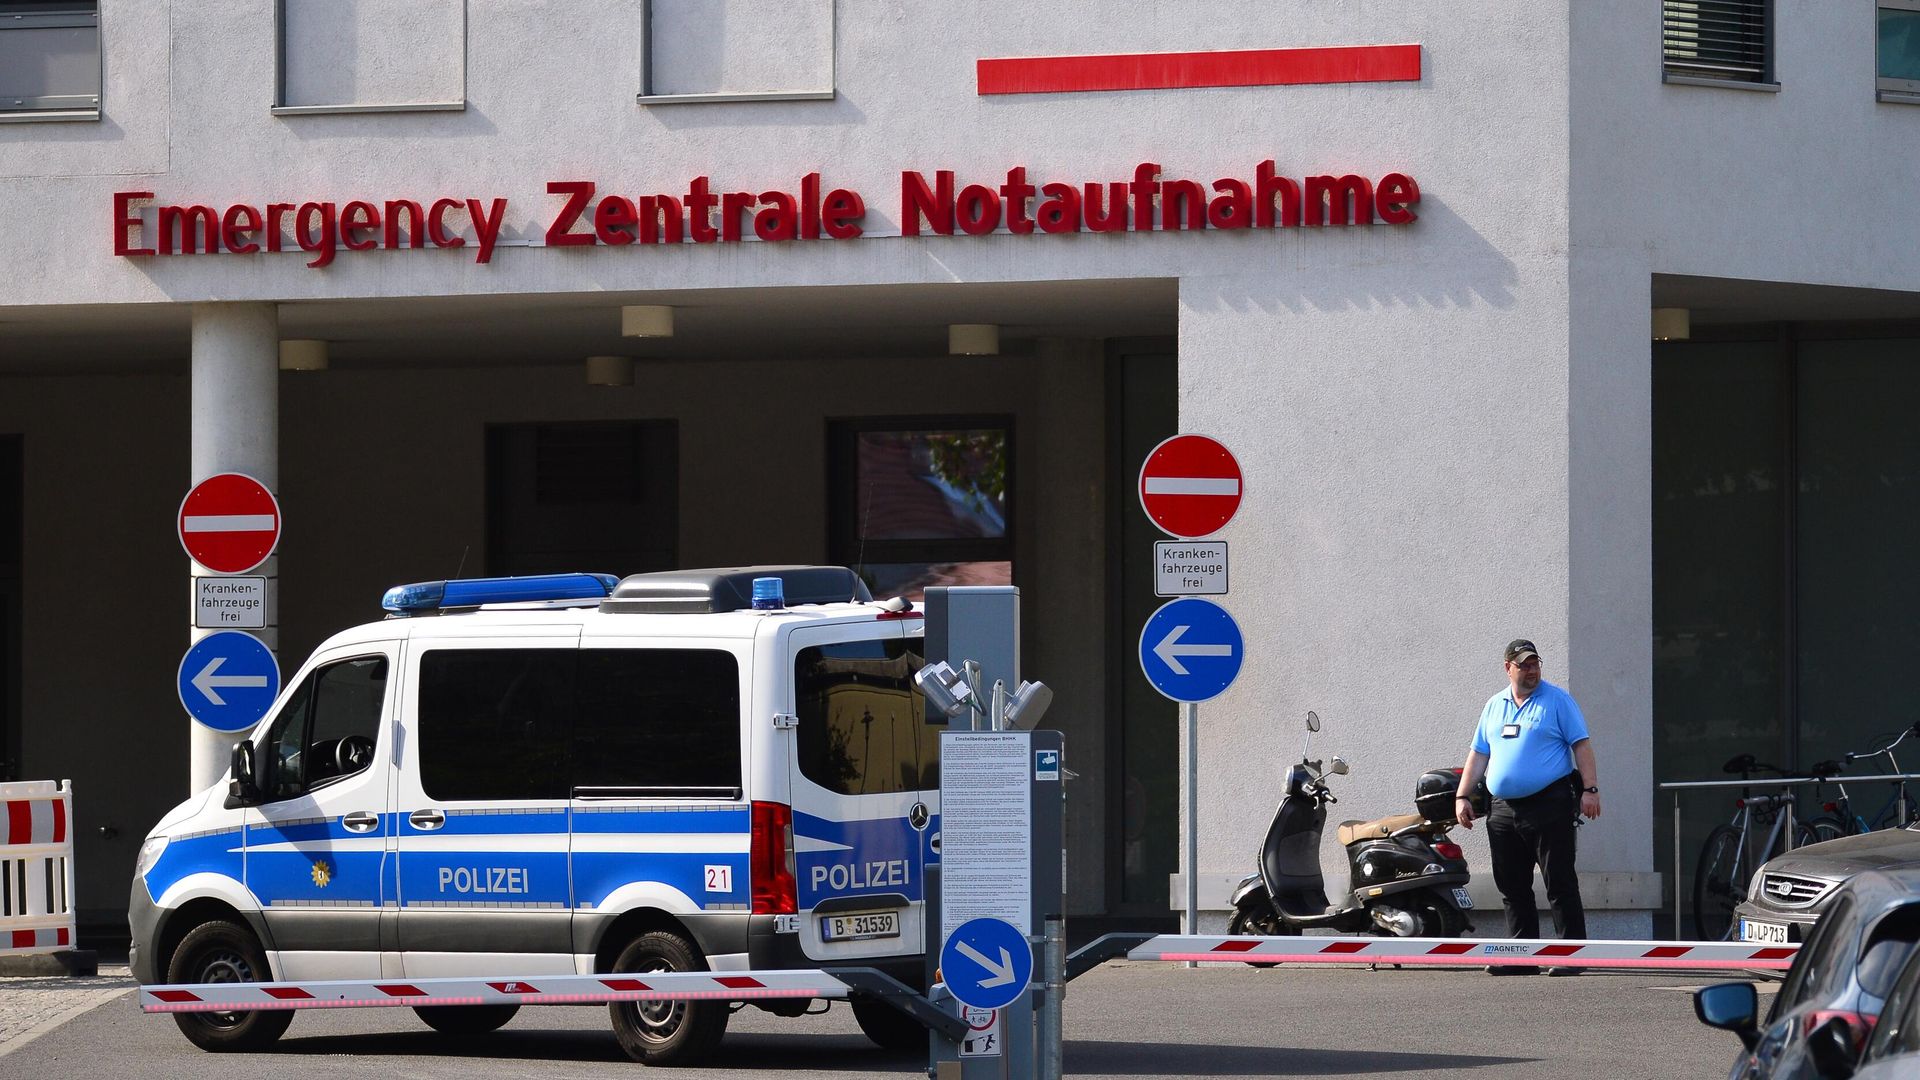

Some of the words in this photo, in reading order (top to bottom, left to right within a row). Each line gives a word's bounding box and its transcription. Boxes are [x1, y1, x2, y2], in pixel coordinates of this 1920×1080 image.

[113, 190, 508, 268] Emergency
[544, 171, 865, 246] Zentrale
[901, 159, 1420, 237] Notaufnahme
[1163, 548, 1220, 559] Kranken-
[1162, 563, 1223, 575] fahrzeuge
[203, 583, 258, 594] Kranken-
[1182, 577, 1203, 588] frei
[201, 597, 260, 610] fahrzeuge
[221, 611, 241, 621] frei
[439, 867, 528, 893] POLIZEI
[707, 868, 727, 889] 21
[811, 860, 909, 892] POLIZEI
[835, 919, 844, 935] B
[855, 916, 893, 934] 31539
[1748, 923, 1754, 939] D
